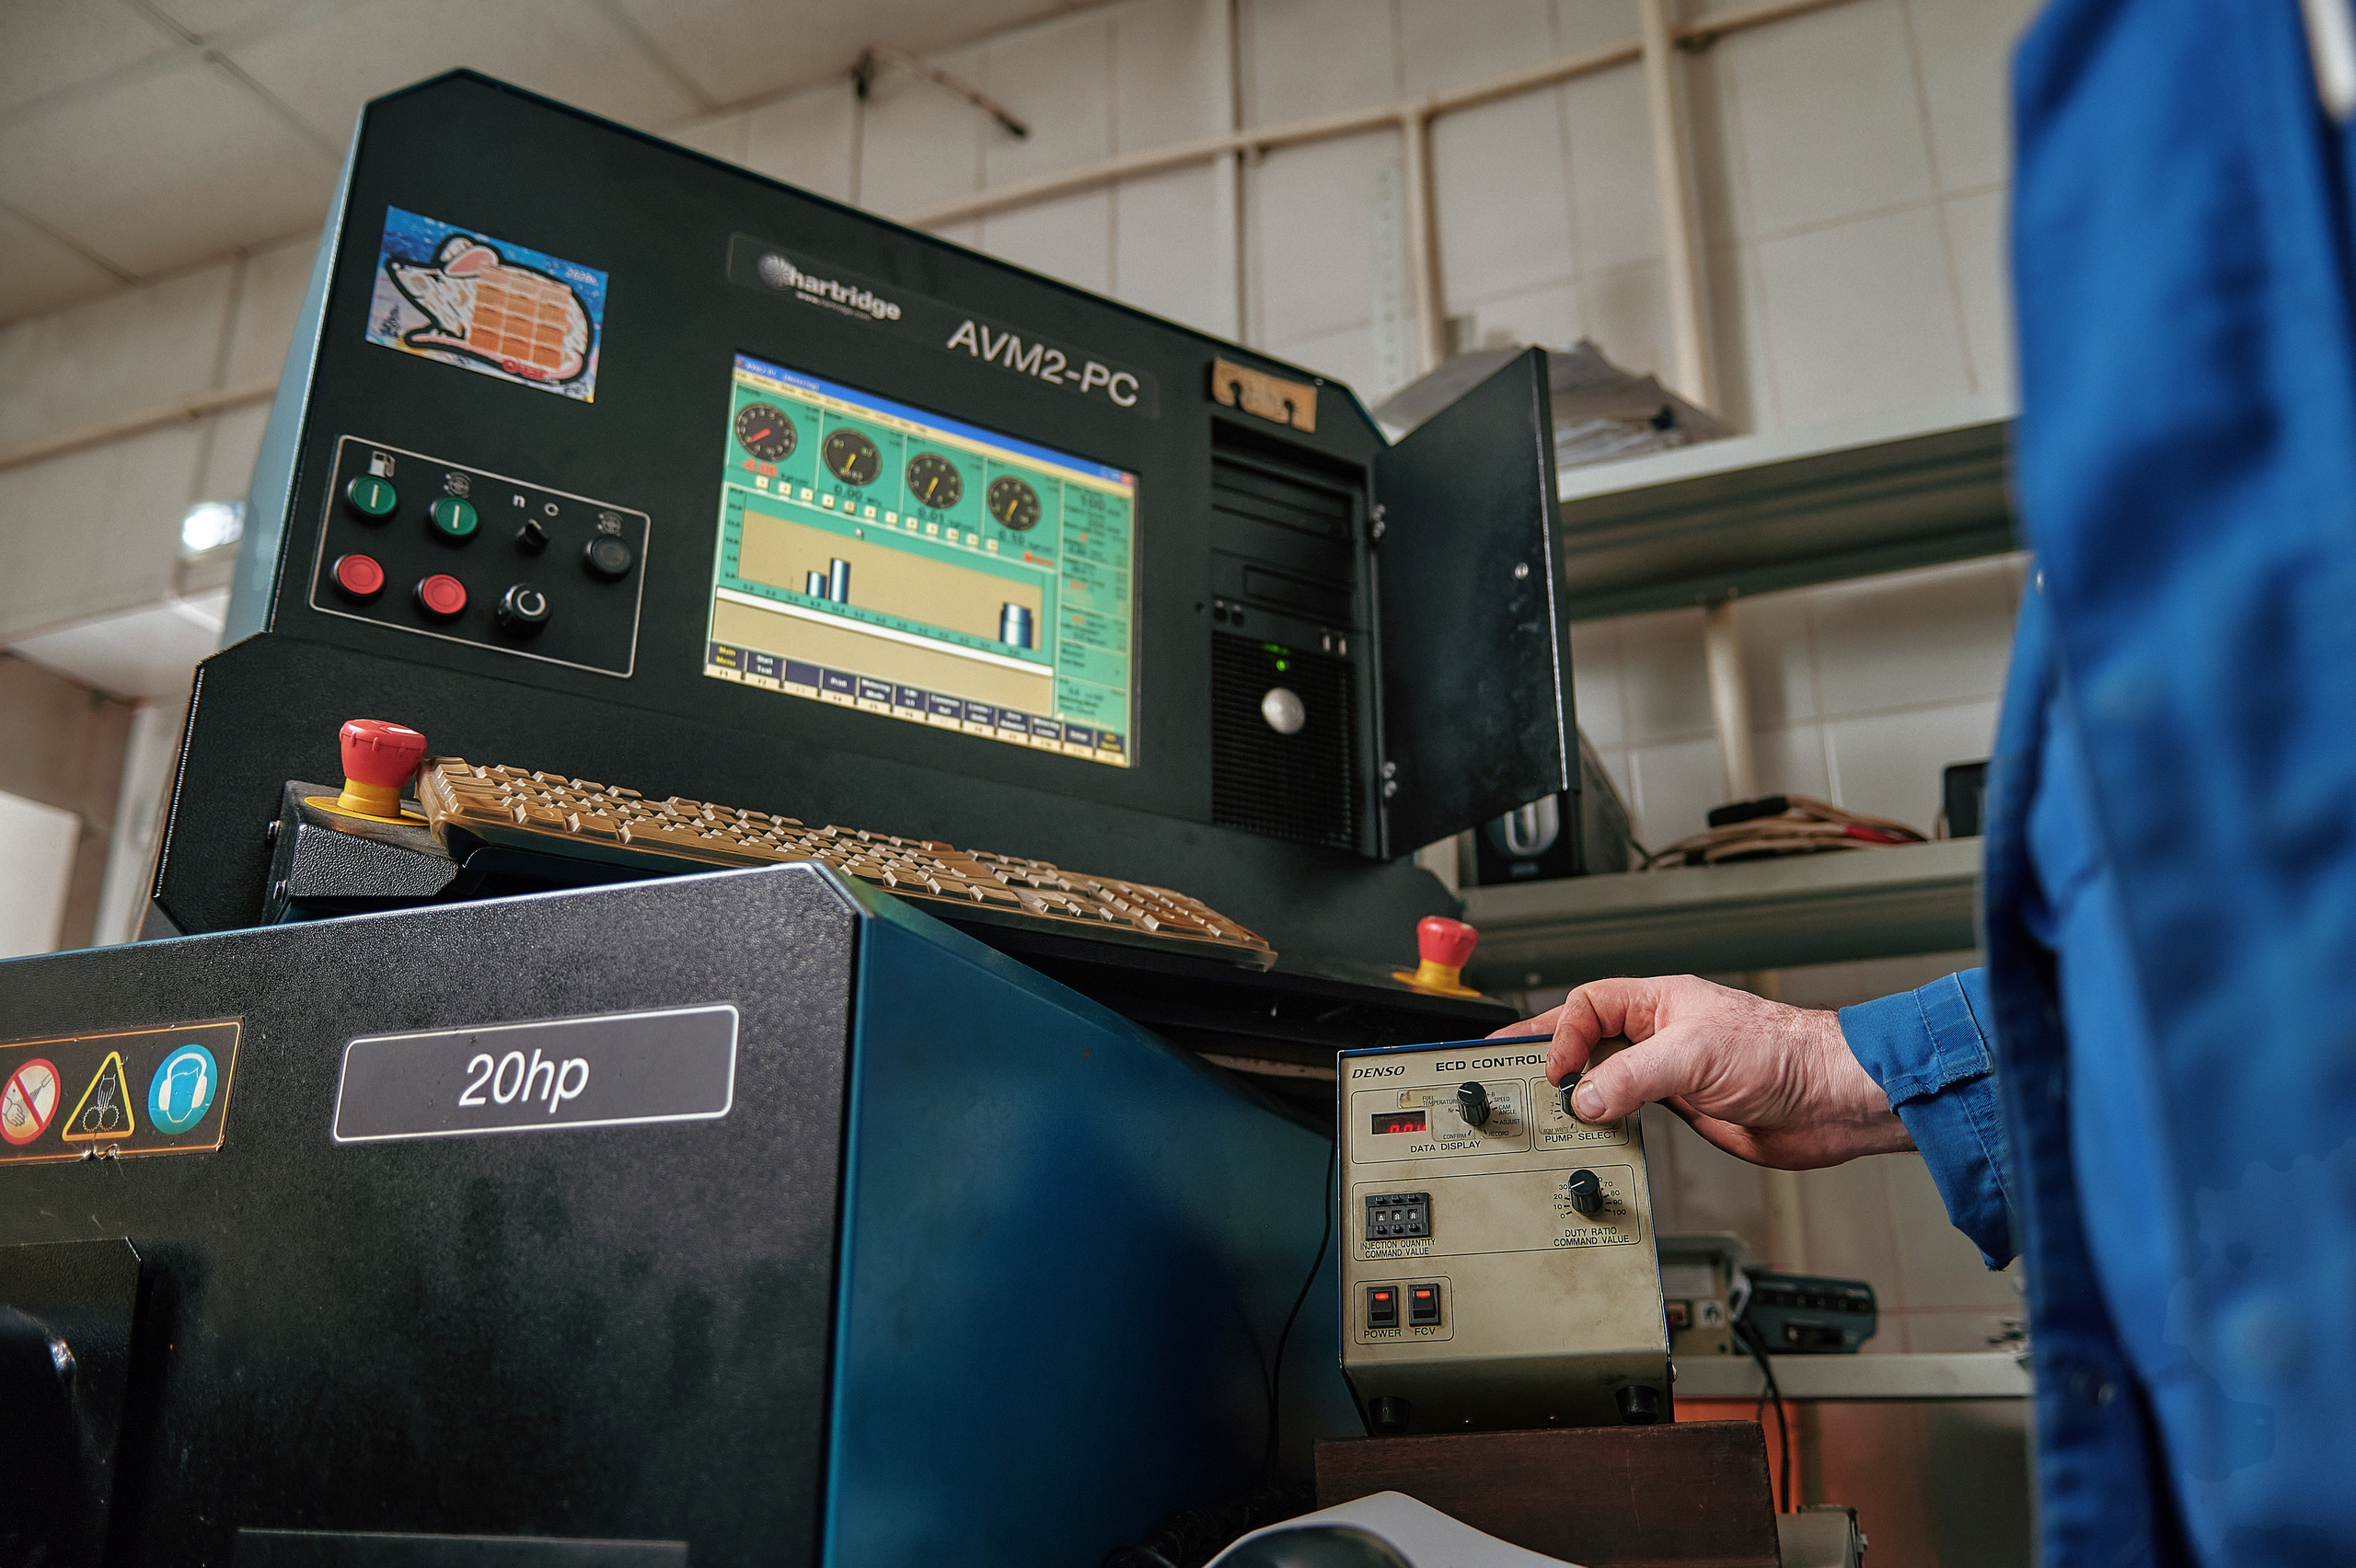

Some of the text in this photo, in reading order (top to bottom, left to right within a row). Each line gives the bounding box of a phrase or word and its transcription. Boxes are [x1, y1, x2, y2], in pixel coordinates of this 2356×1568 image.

[788, 265, 902, 320] hartridge
[946, 319, 1140, 408] AVM2-PC
[1435, 1054, 1547, 1072] ECD CONTROL
[1351, 1066, 1406, 1079] DENSO
[458, 1048, 590, 1114] 20hp
[1544, 1130, 1618, 1143] PUMP SELECT
[1410, 1140, 1481, 1153] DATA DISPLAY
[1565, 1227, 1617, 1238] DUTY RATIO
[1359, 1238, 1436, 1250] INJECTION QUANTITY
[1553, 1235, 1629, 1247] COMMAND VALUE
[1365, 1247, 1429, 1258] COMMAND VALUE
[1363, 1329, 1402, 1339] POWER
[1415, 1327, 1436, 1335] FCV
